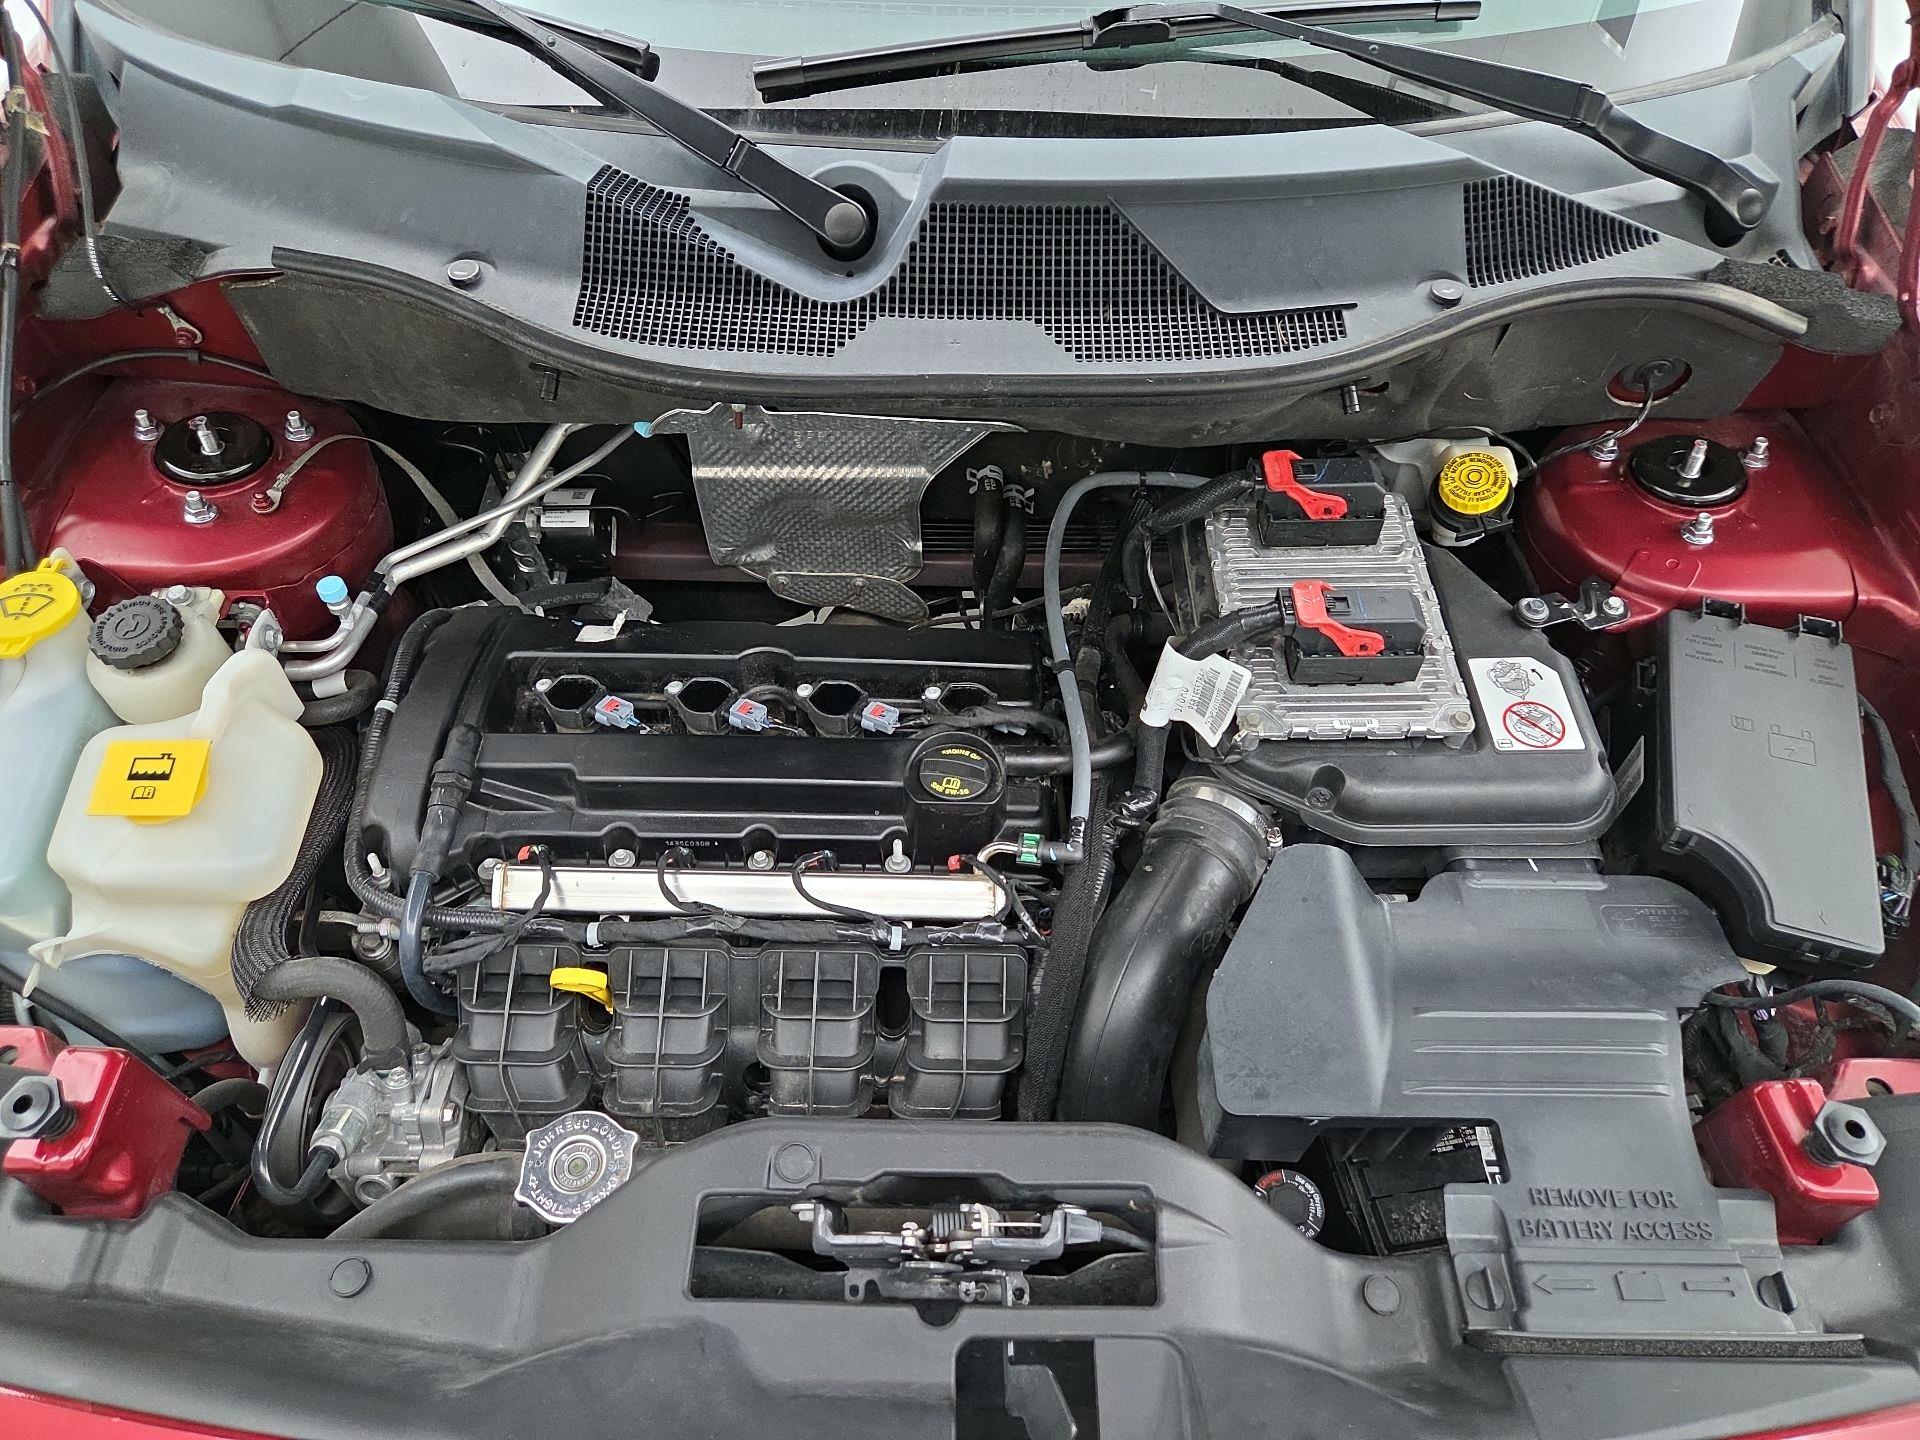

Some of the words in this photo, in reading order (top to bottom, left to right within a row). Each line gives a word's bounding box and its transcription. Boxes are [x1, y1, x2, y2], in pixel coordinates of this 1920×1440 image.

[530, 1189, 564, 1216] TIGHT
[1529, 1186, 1626, 1208] REMOVE
[1629, 1188, 1679, 1209] FOR
[1518, 1218, 1614, 1240] BATTERY
[1624, 1221, 1715, 1241] ACCESS
